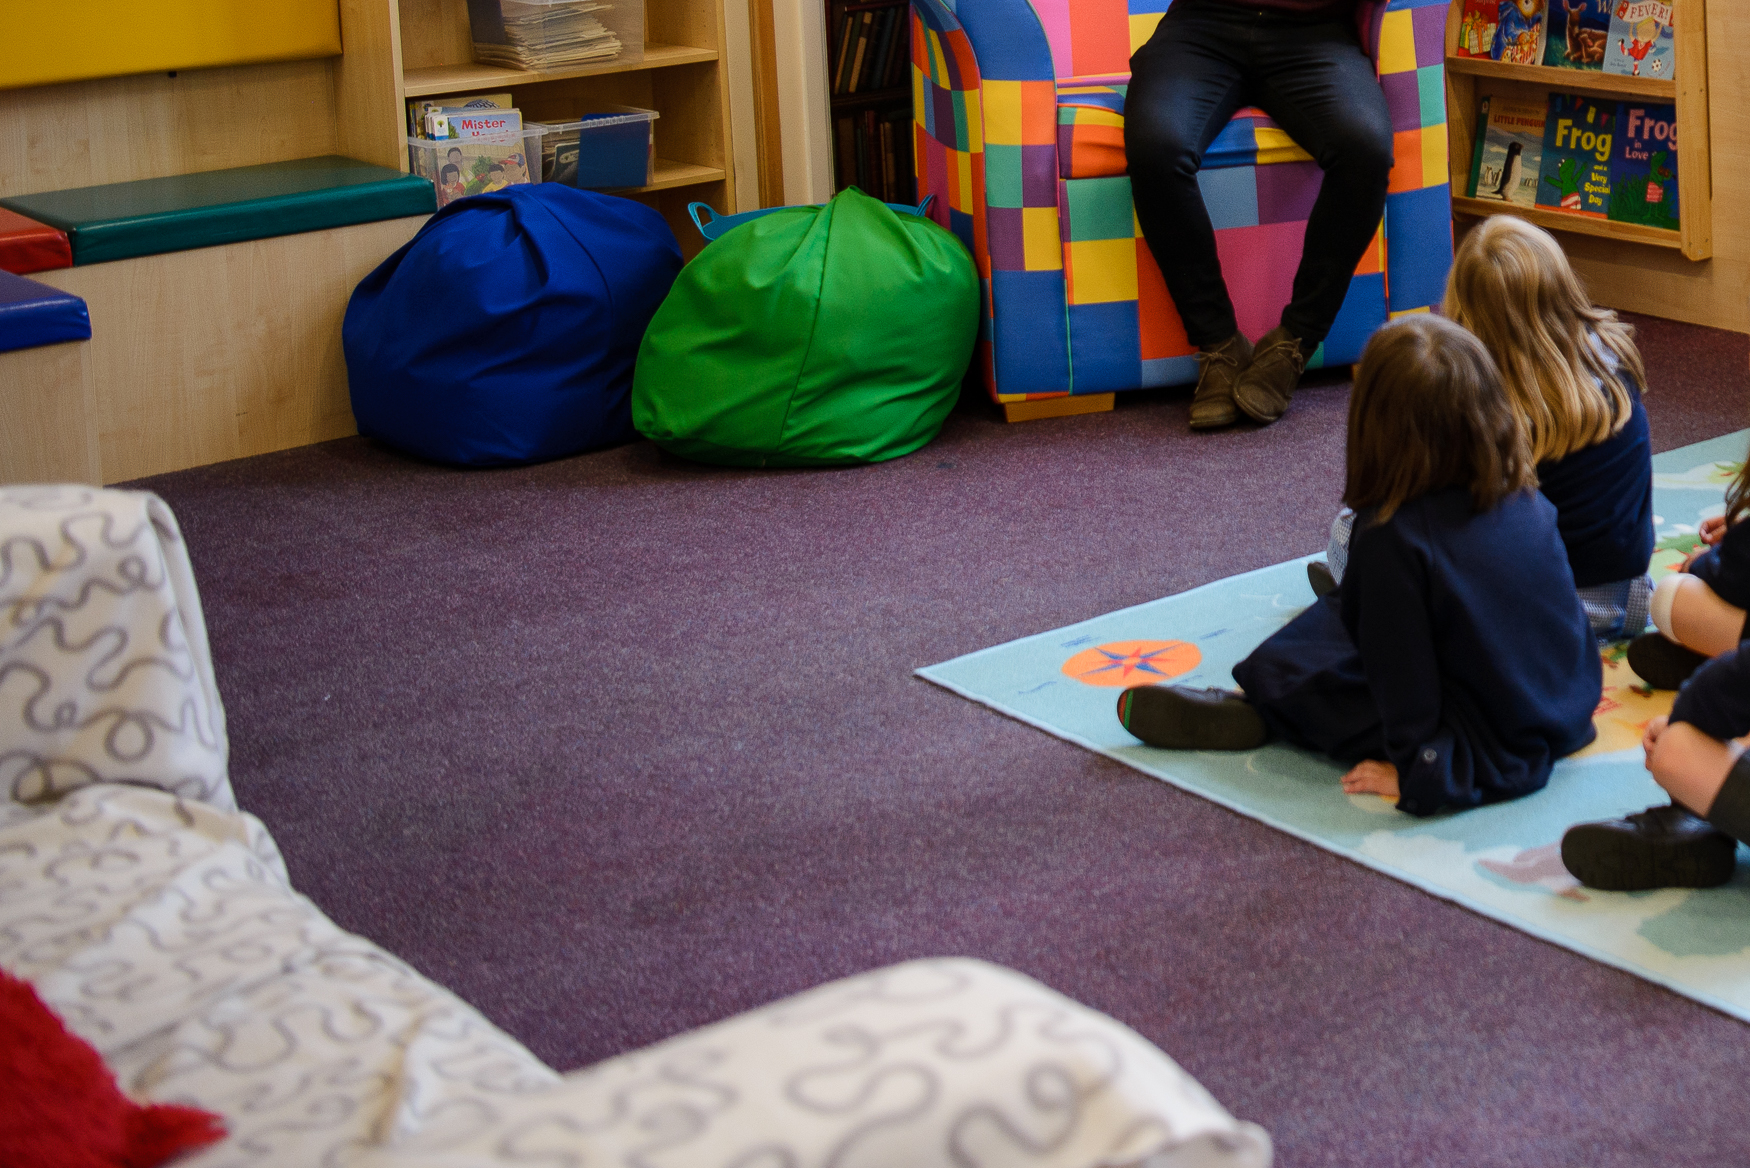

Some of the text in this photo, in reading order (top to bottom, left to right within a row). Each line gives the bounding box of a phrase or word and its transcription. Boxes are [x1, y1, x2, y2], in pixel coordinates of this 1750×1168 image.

[1629, 3, 1669, 19] FEVER!
[462, 119, 506, 131] Mister
[1494, 115, 1515, 126] LITTLE
[1555, 118, 1612, 162] Frog
[1634, 140, 1642, 149] in
[1625, 146, 1649, 160] Love
[1591, 172, 1608, 184] Very
[1584, 182, 1611, 194] Special
[1588, 194, 1603, 206] Day
